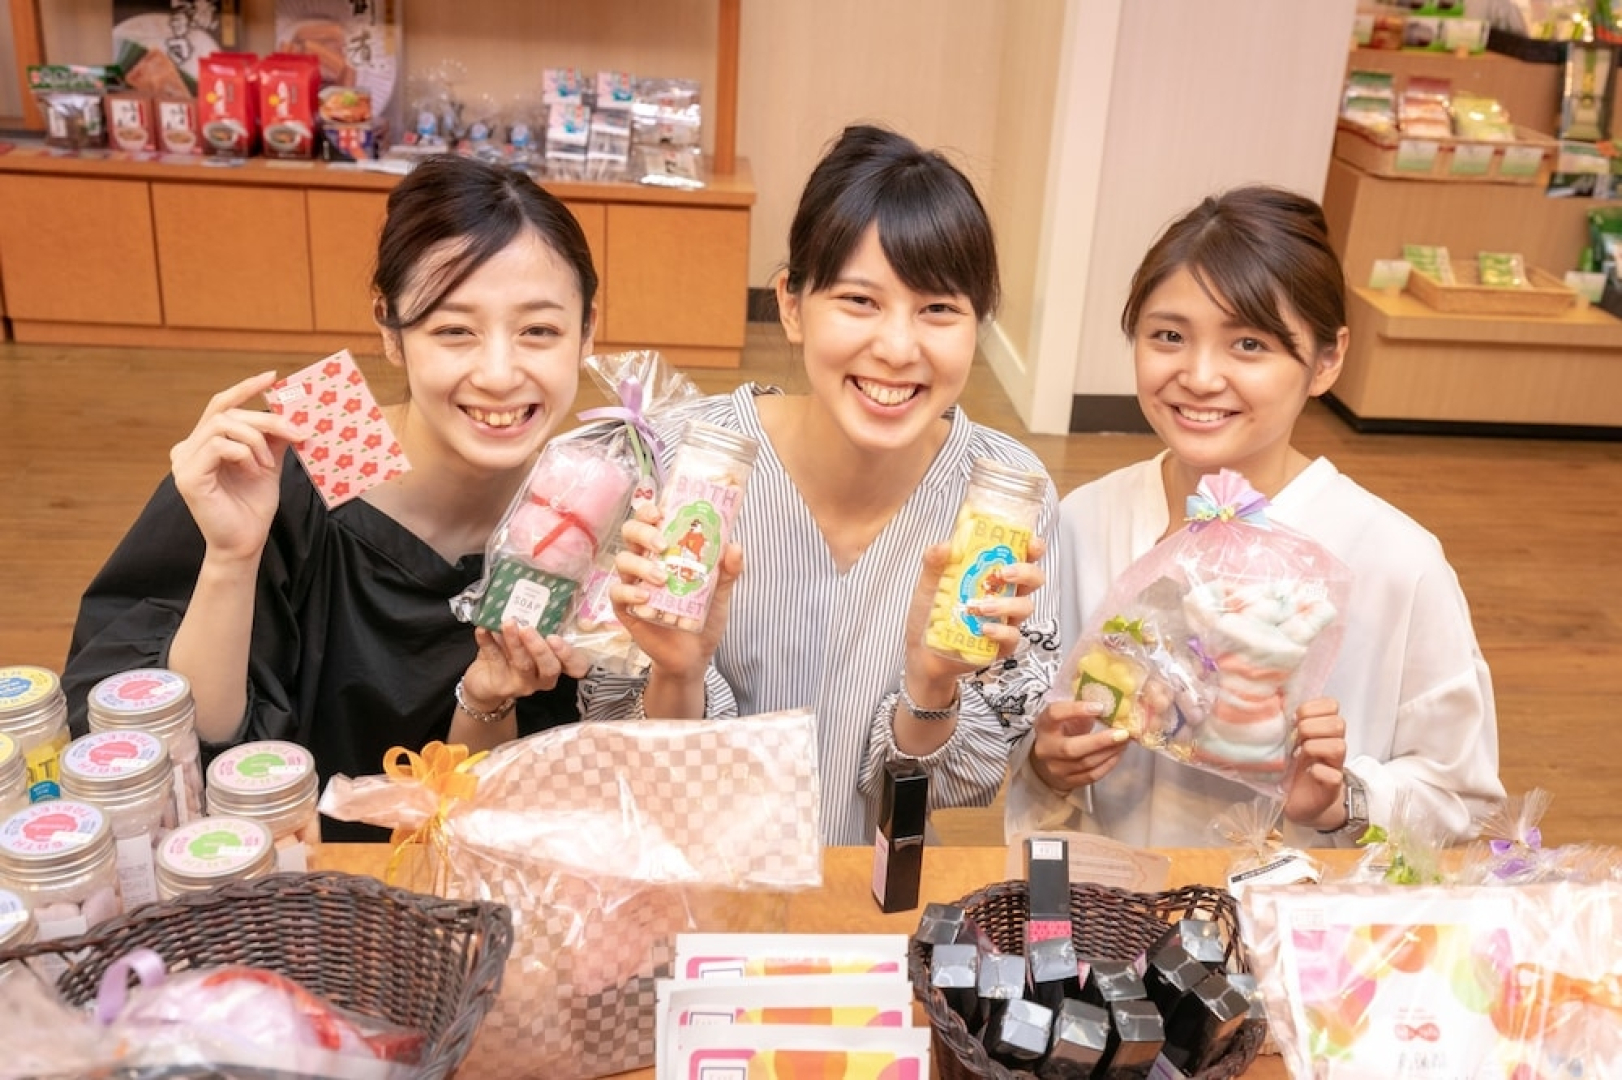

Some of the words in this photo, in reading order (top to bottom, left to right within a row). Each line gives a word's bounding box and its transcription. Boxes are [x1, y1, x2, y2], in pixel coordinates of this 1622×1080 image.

[676, 475, 737, 507] BATH
[974, 519, 1031, 548] BATH
[513, 595, 541, 611] SOAP
[651, 591, 705, 616] ABLET
[945, 628, 999, 653] TABLE
